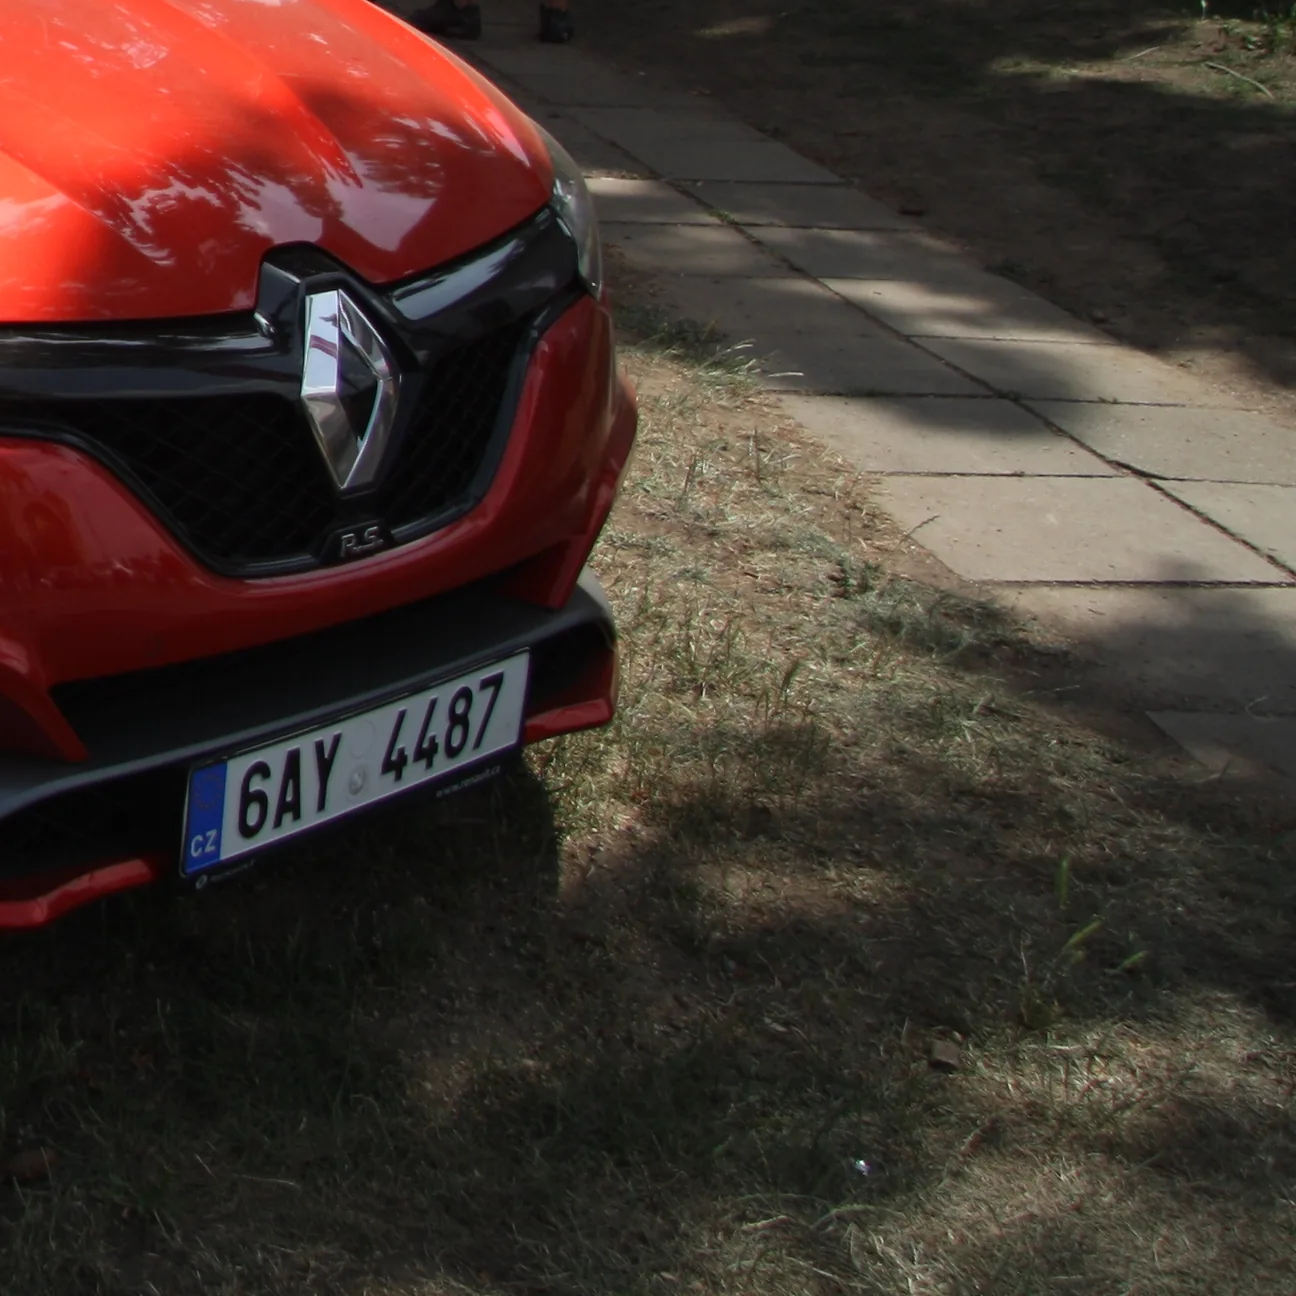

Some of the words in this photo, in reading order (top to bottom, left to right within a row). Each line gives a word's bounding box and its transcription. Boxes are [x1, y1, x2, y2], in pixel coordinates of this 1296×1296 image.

[237, 731, 343, 840] 6AY
[379, 670, 506, 783] 4487
[190, 829, 218, 858] CZ
